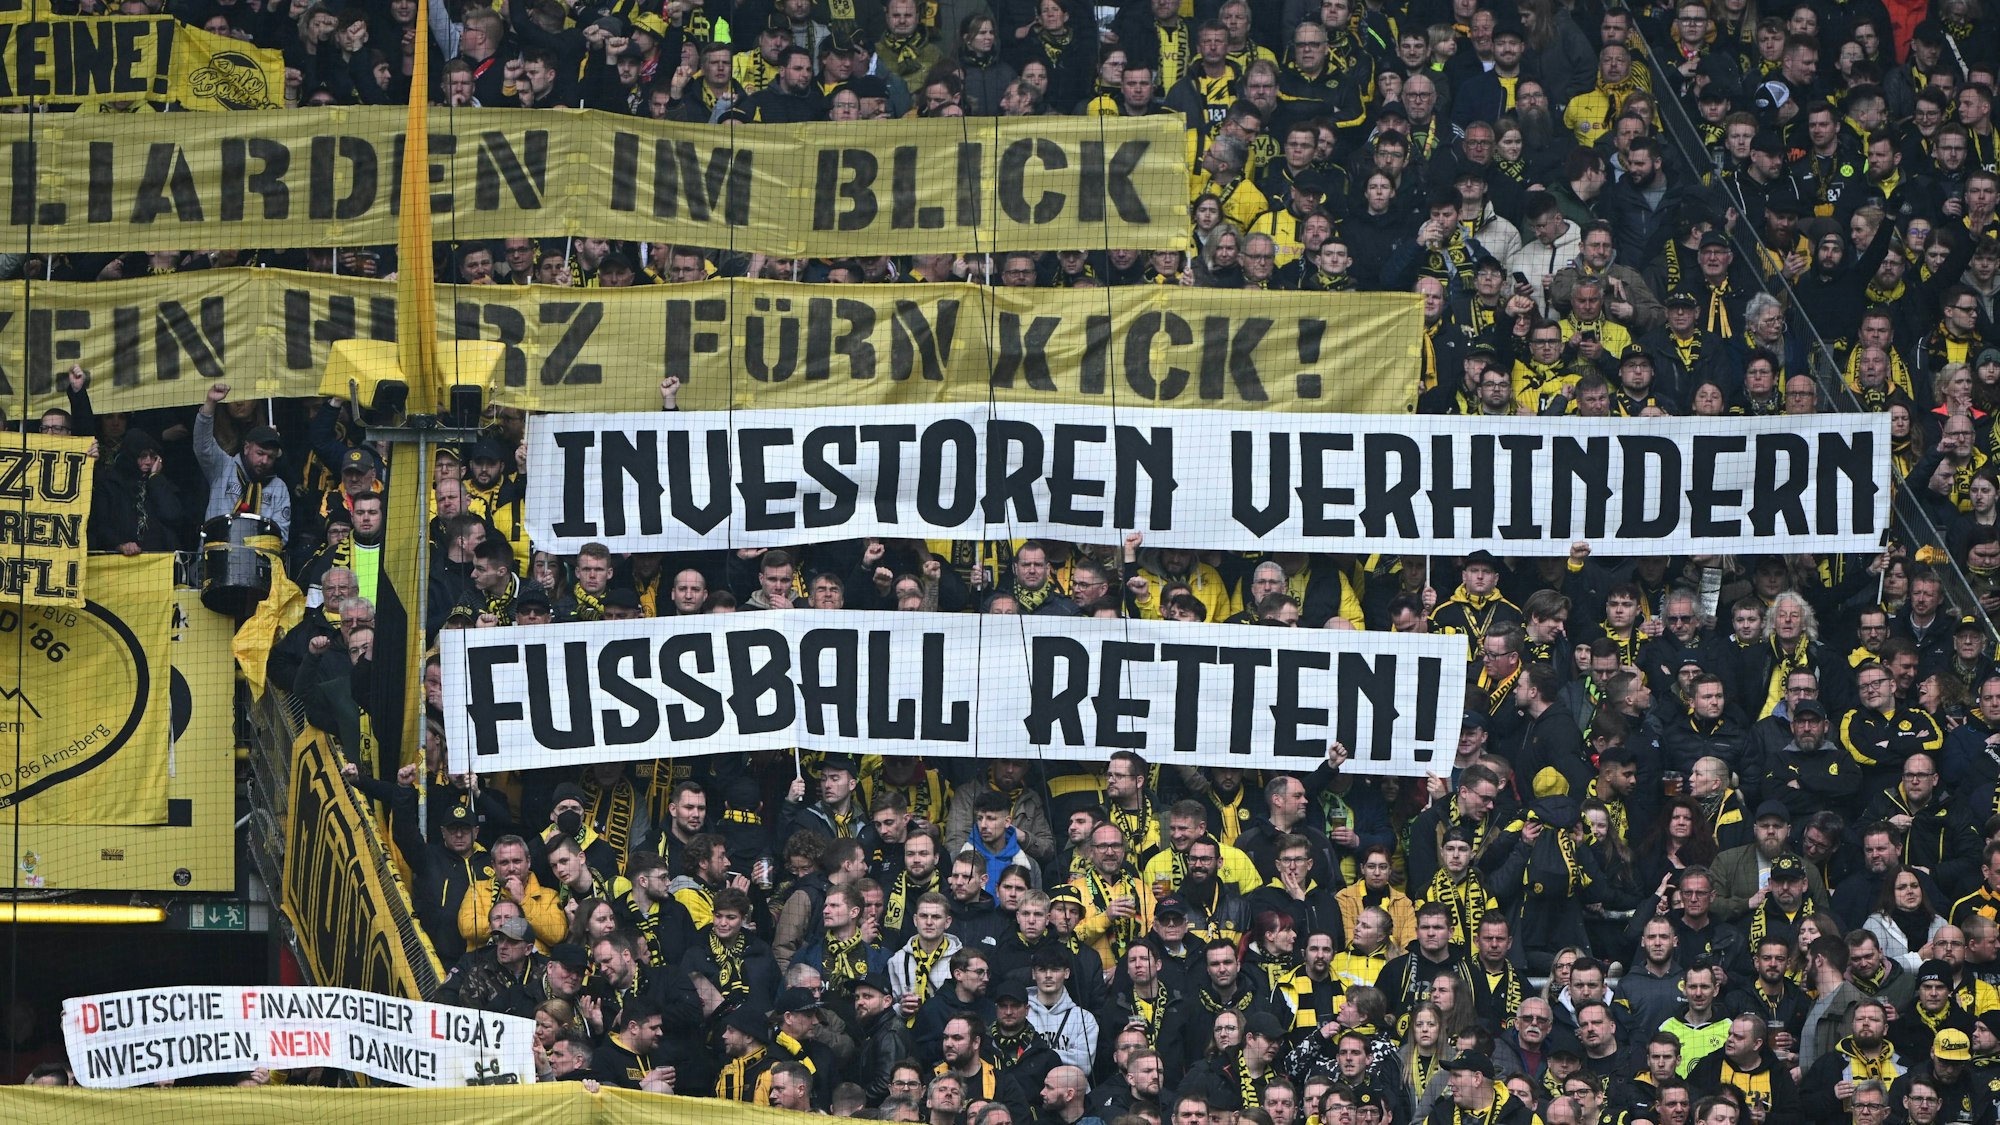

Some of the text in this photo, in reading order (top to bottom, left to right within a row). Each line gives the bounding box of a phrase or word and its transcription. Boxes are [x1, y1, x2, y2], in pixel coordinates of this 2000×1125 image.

[1208, 108, 1227, 122] 1&1
[11, 130, 1151, 231] LIARDEN IM BLICK
[1828, 188, 1842, 202] &1
[664, 297, 961, 384] FÜRN
[990, 310, 1327, 401] KICK!
[551, 418, 1880, 539] INVESTOREN VERHINDERN
[0, 556, 79, 599] FL!
[466, 628, 1442, 762] FUSSBALL RETTEN!
[42, 723, 112, 769] Arnsberg
[888, 901, 900, 918] VB
[81, 992, 505, 1050] DEUTSCHE FINANZGEIER LIGA?
[86, 1030, 436, 1082] INVESTOREN, NEIN DANKE!
